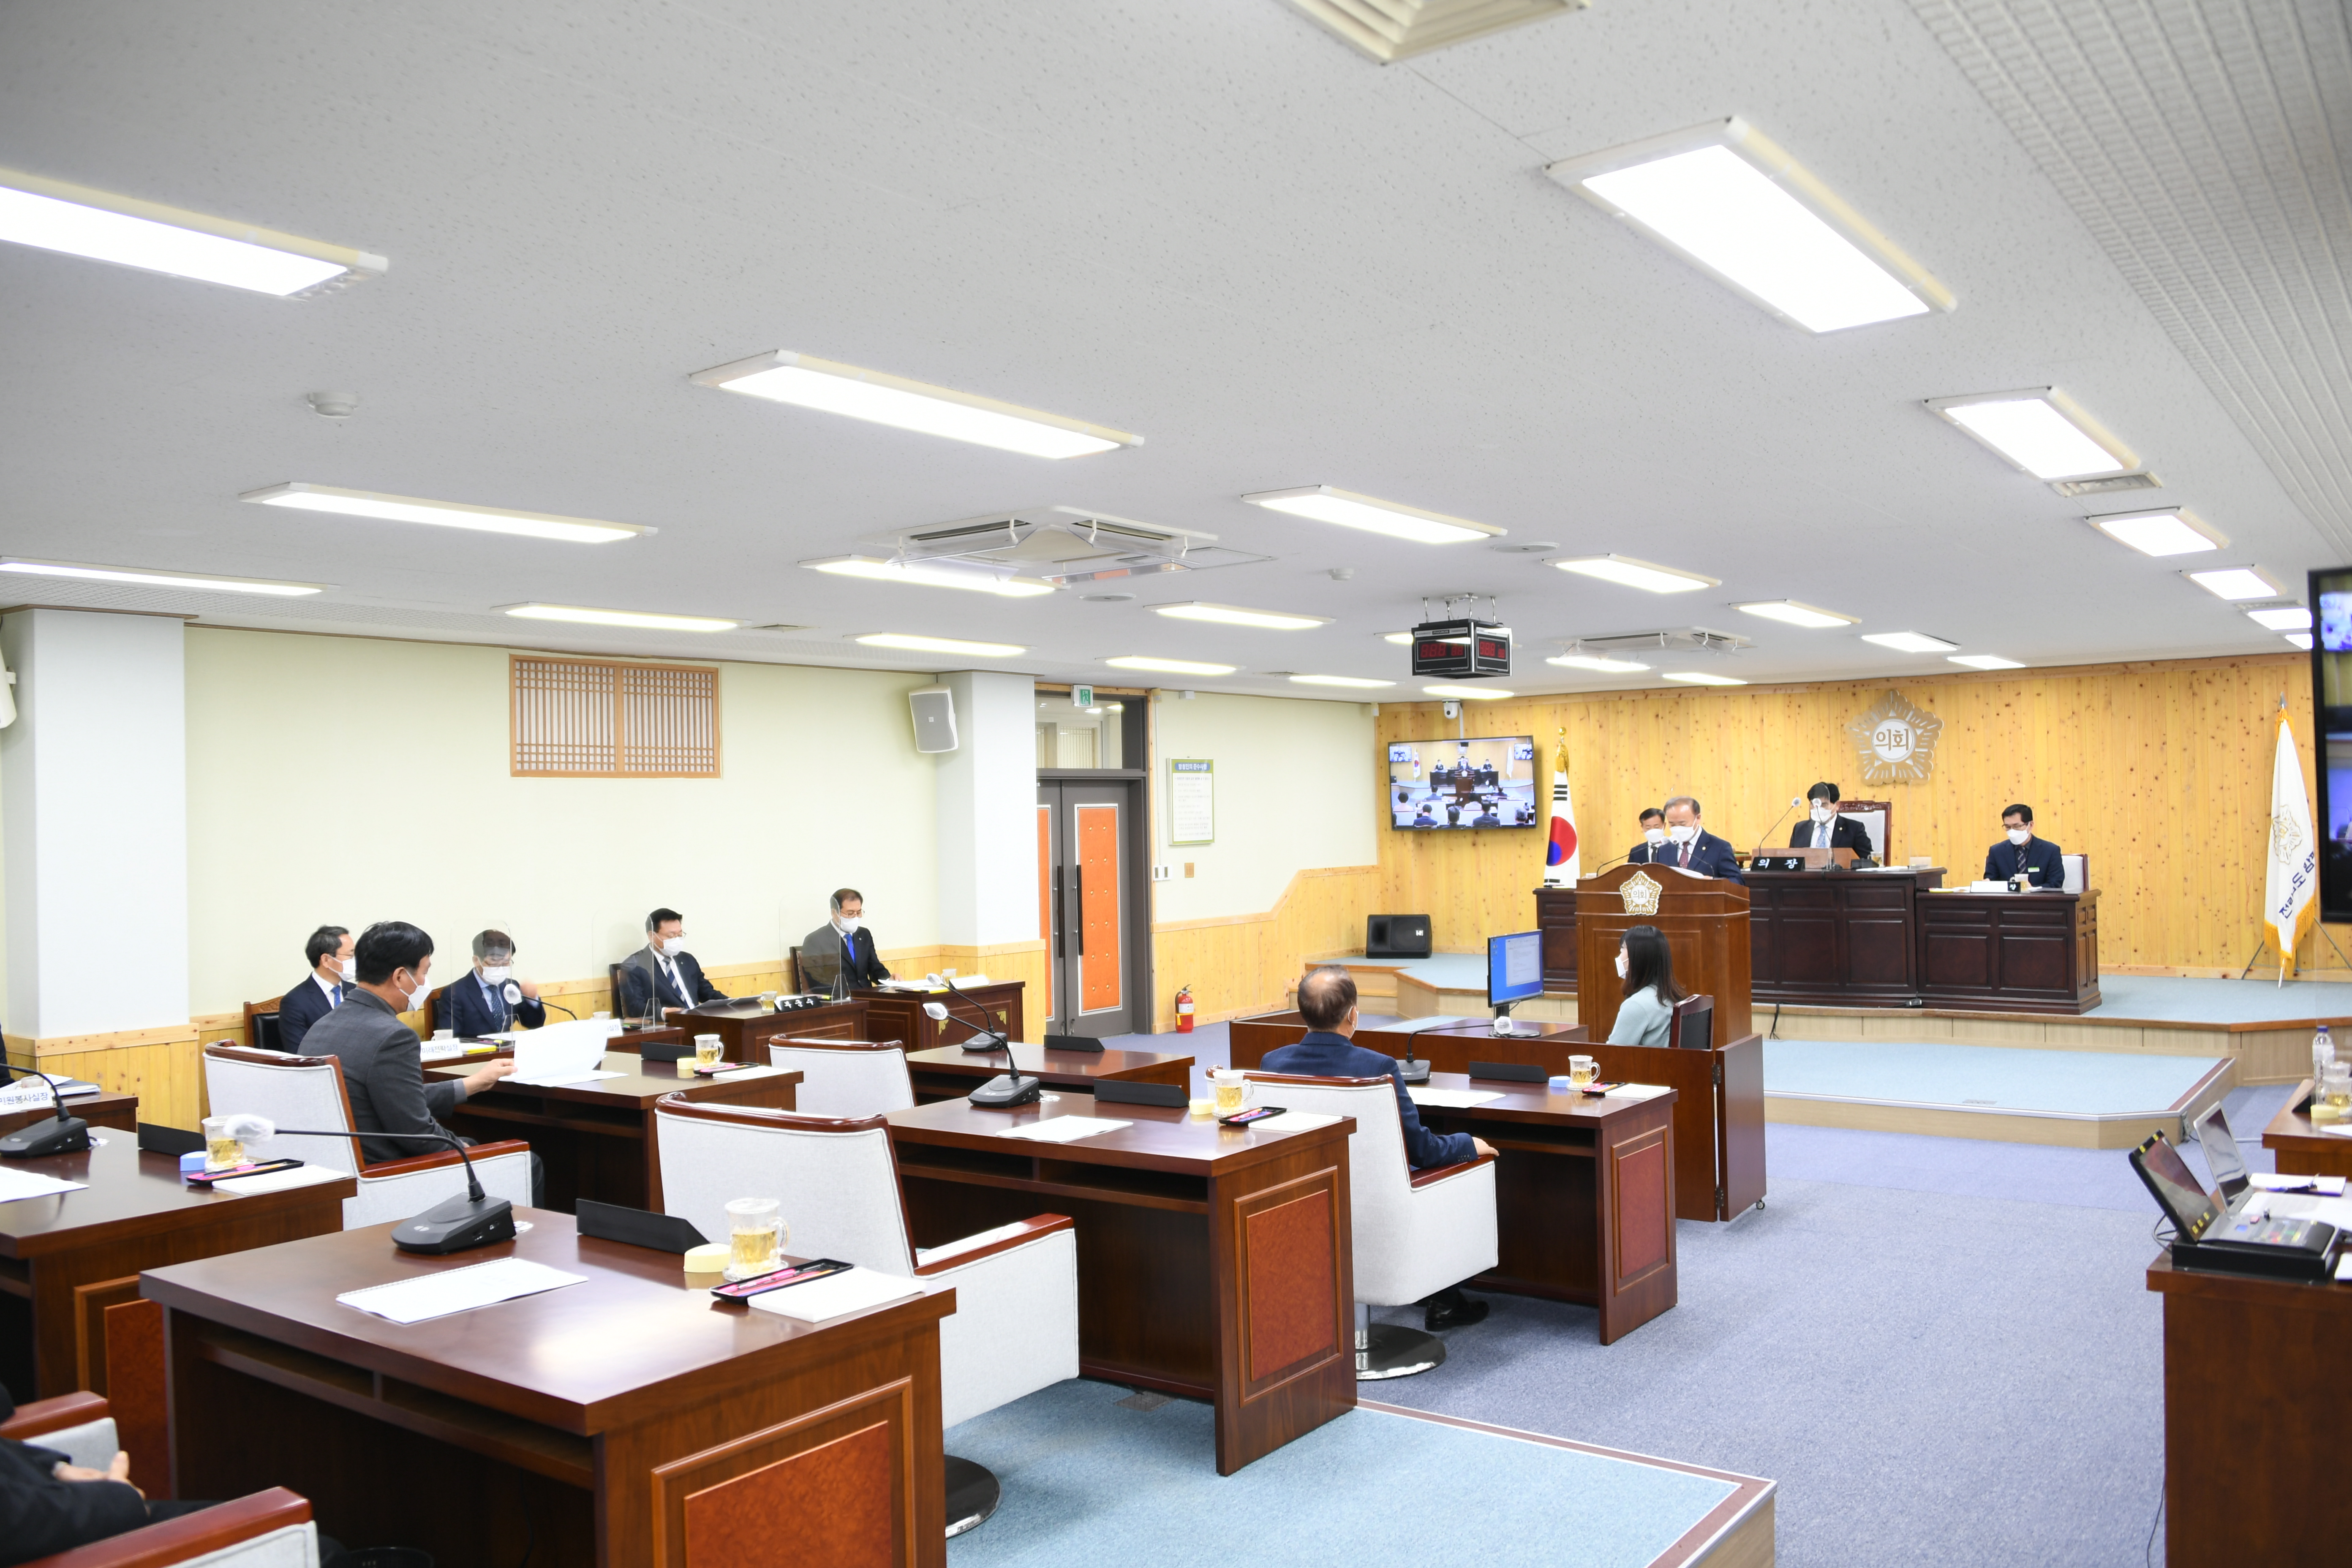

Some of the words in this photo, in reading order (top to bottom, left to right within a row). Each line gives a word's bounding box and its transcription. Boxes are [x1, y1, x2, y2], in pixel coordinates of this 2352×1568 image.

[1875, 728, 1910, 751] 의회
[1633, 890, 1647, 900] 의회
[422, 1044, 458, 1054] 미래전략실장
